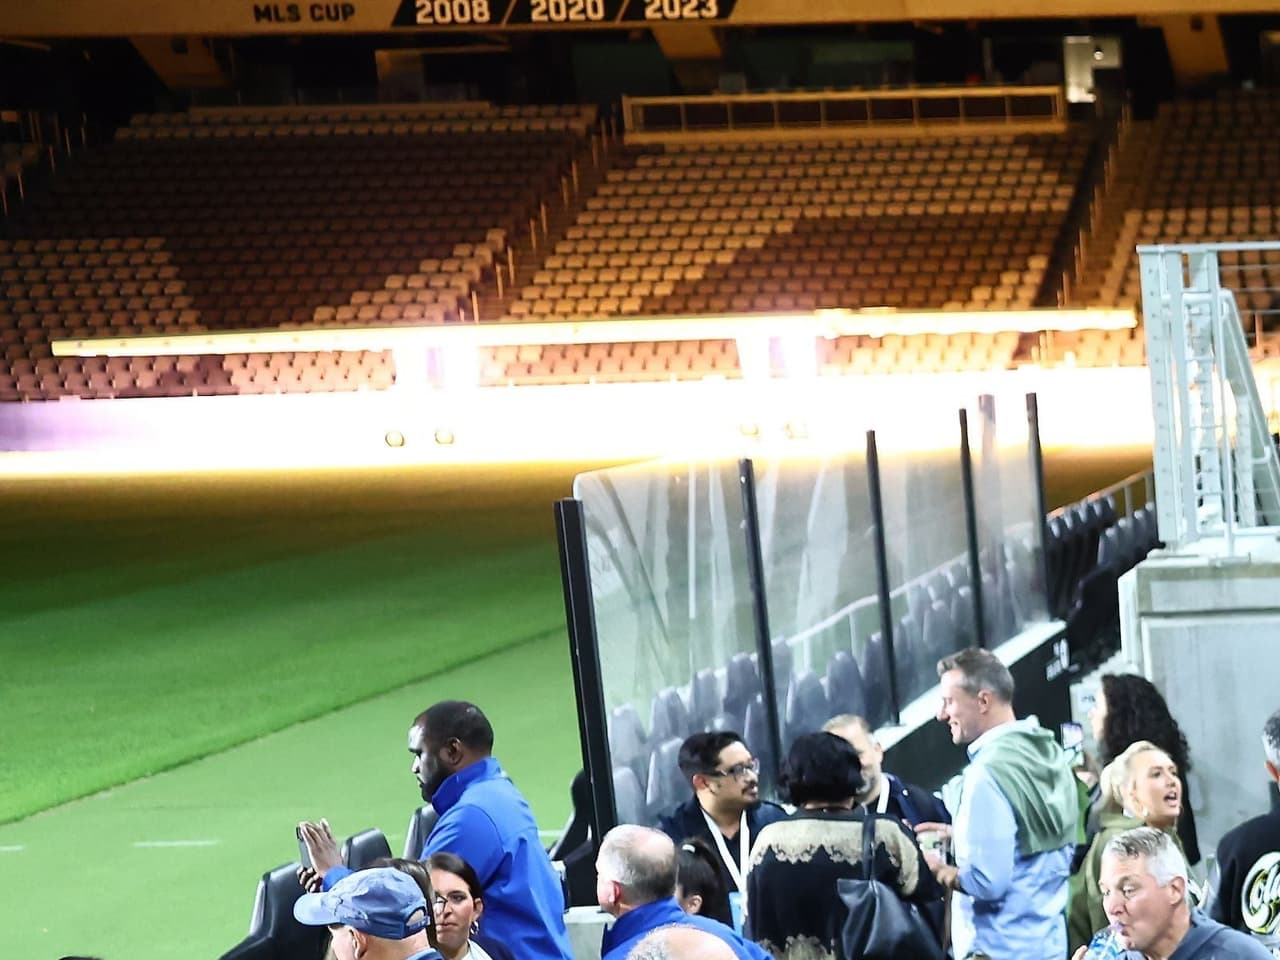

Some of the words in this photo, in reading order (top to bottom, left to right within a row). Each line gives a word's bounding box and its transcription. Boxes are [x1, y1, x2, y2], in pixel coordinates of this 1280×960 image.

[253, 4, 299, 23] MLS
[309, 3, 355, 22] CUP
[415, 0, 490, 25] 2008
[530, 0, 605, 22] 2020
[644, 0, 719, 20] 2023
